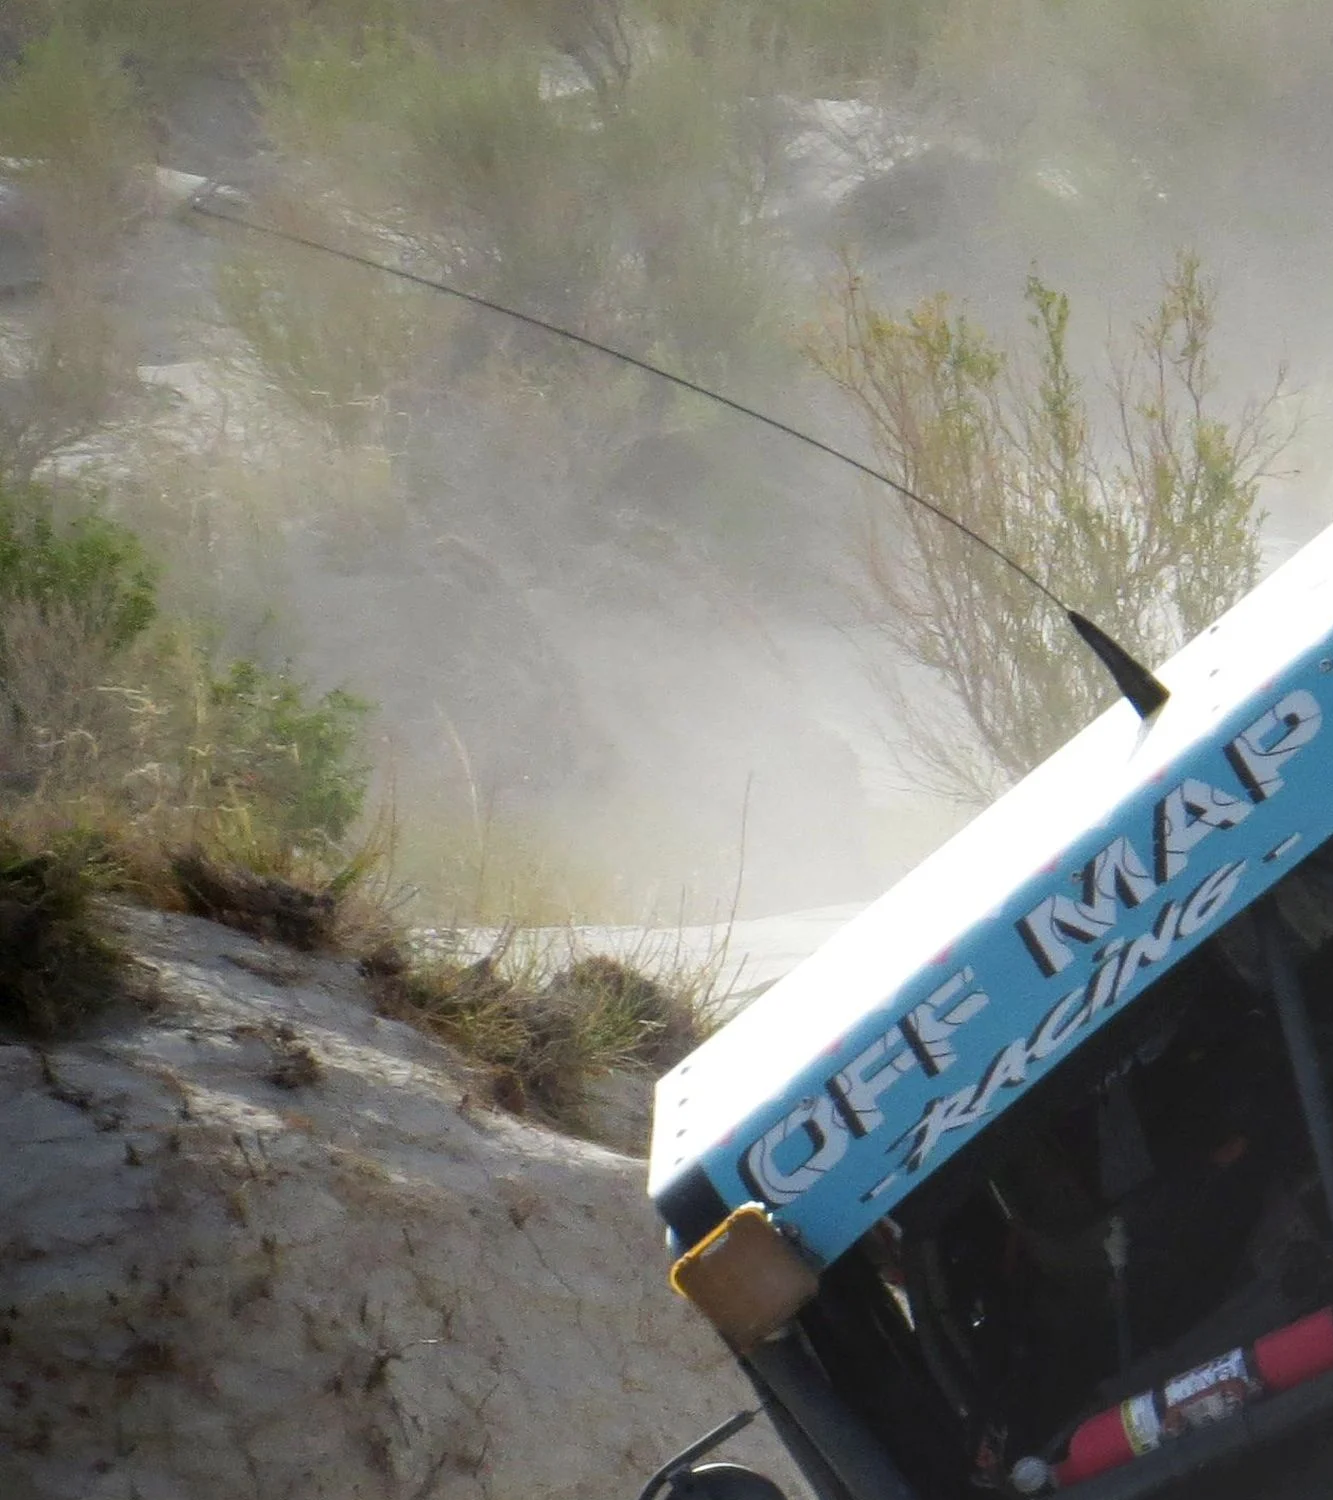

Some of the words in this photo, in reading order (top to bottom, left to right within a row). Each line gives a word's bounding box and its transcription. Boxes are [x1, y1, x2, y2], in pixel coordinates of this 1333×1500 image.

[737, 965, 990, 1207] OFF
[1014, 688, 1322, 979] MAP
[885, 857, 1249, 1174] RACING
